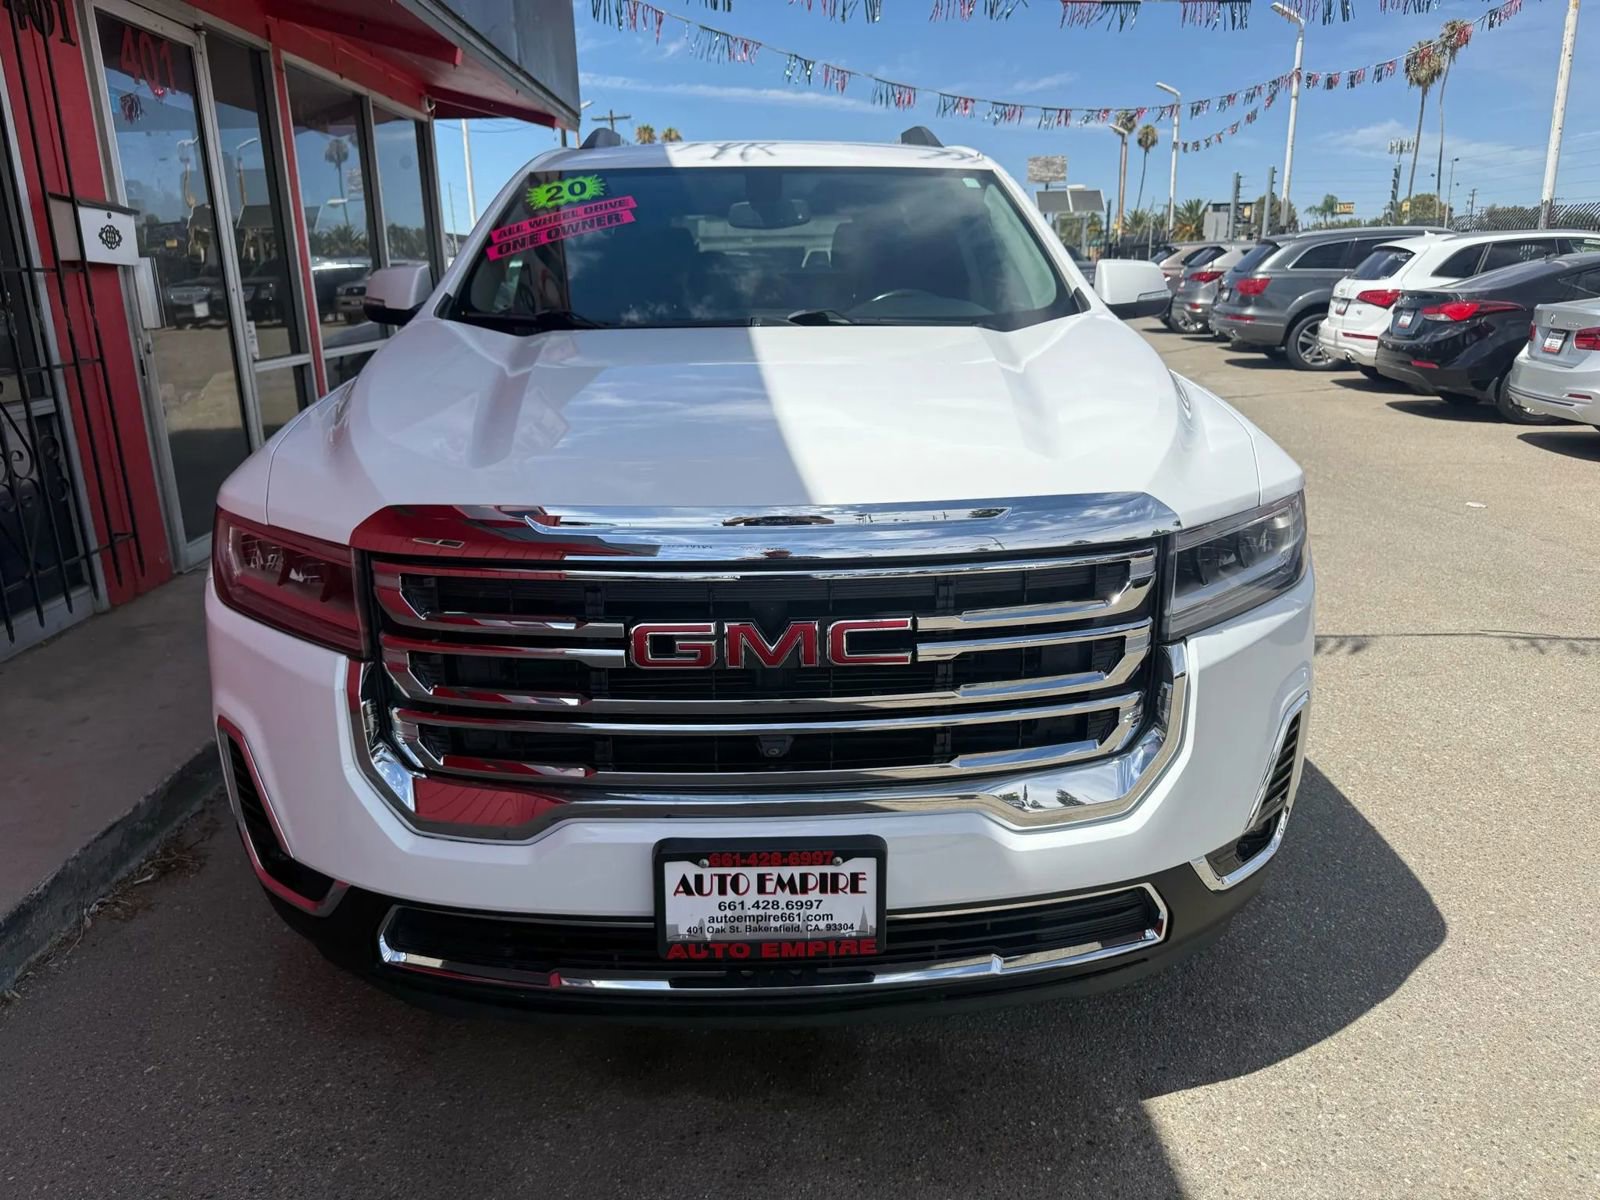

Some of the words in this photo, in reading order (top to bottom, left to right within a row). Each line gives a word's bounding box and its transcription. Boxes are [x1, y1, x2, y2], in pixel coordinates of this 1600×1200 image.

[118, 26, 177, 101] 401
[545, 181, 587, 203] 20
[497, 224, 525, 239] ALL
[528, 208, 579, 229] WHEEL
[583, 199, 627, 214] DRIVE
[497, 233, 542, 255] ONE
[546, 213, 623, 240] OWNER
[630, 617, 913, 669] GMC
[708, 851, 834, 867] 661-428-6997
[673, 872, 751, 897] AUTO
[757, 872, 867, 896] EMPIRE
[718, 899, 823, 911] 661.428.6997
[686, 926, 703, 935] 401
[706, 925, 726, 934] Oak
[729, 925, 742, 934] St.
[825, 922, 854, 932] 93304
[708, 911, 834, 924] autoempire661.com
[666, 942, 750, 960] AUTO
[761, 938, 878, 959] EMPIRE
